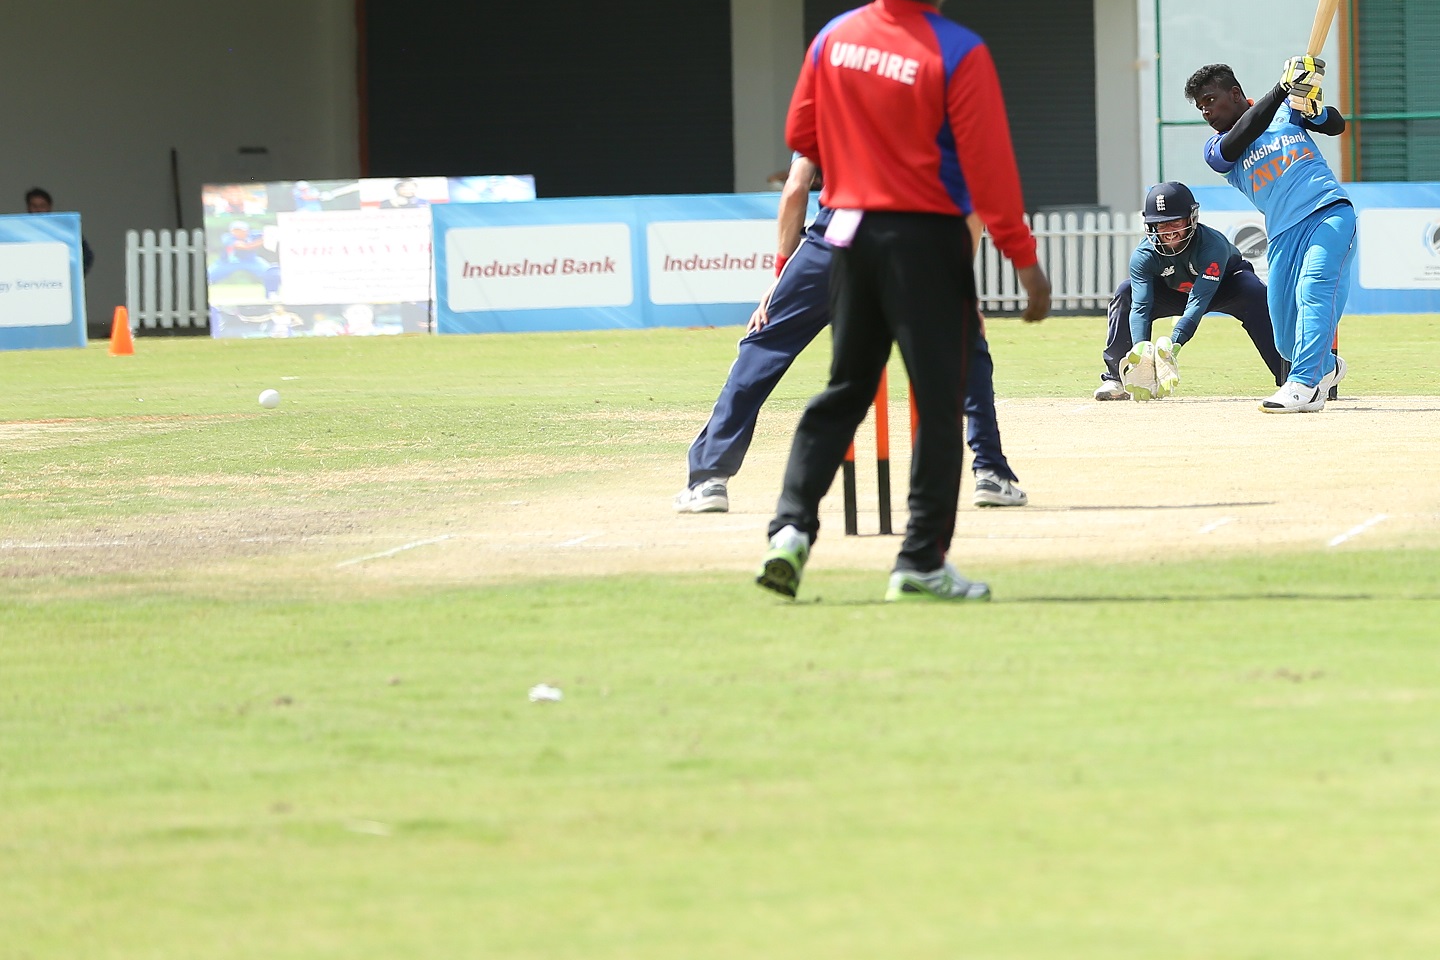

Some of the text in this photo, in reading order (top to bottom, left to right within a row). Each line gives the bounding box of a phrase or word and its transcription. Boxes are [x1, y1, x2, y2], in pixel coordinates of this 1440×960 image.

[830, 41, 920, 86] UMPIRE
[1242, 132, 1308, 172] ndusInd Bank
[461, 256, 617, 279] IndusInd Bank
[662, 253, 757, 271] IndusInd
[15, 279, 64, 291] Services
